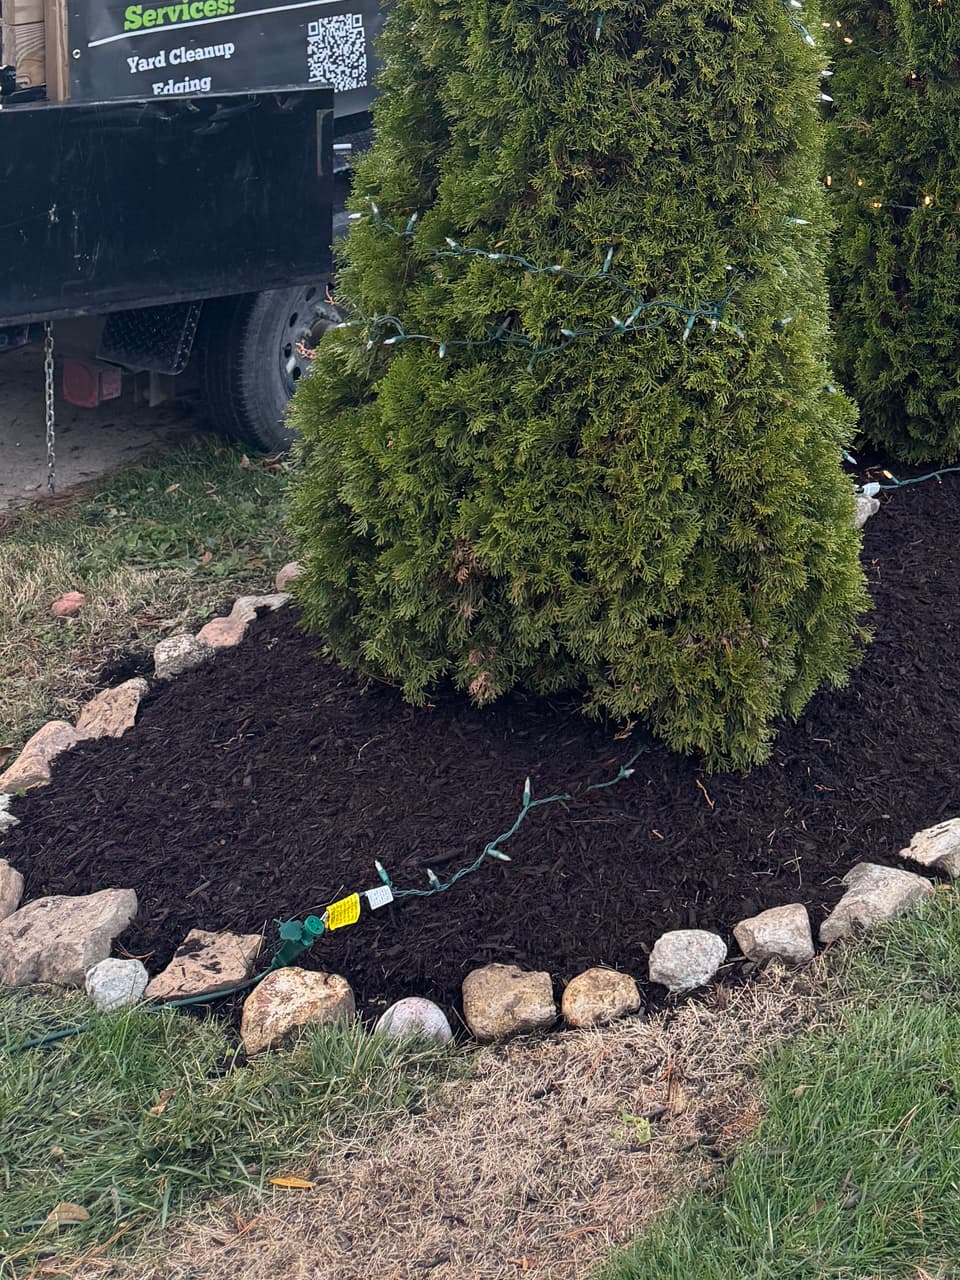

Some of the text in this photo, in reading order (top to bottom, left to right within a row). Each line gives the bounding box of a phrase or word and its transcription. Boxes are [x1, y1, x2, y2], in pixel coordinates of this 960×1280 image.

[127, 42, 235, 73] Yard Cleanup
[152, 76, 212, 95] Edging
